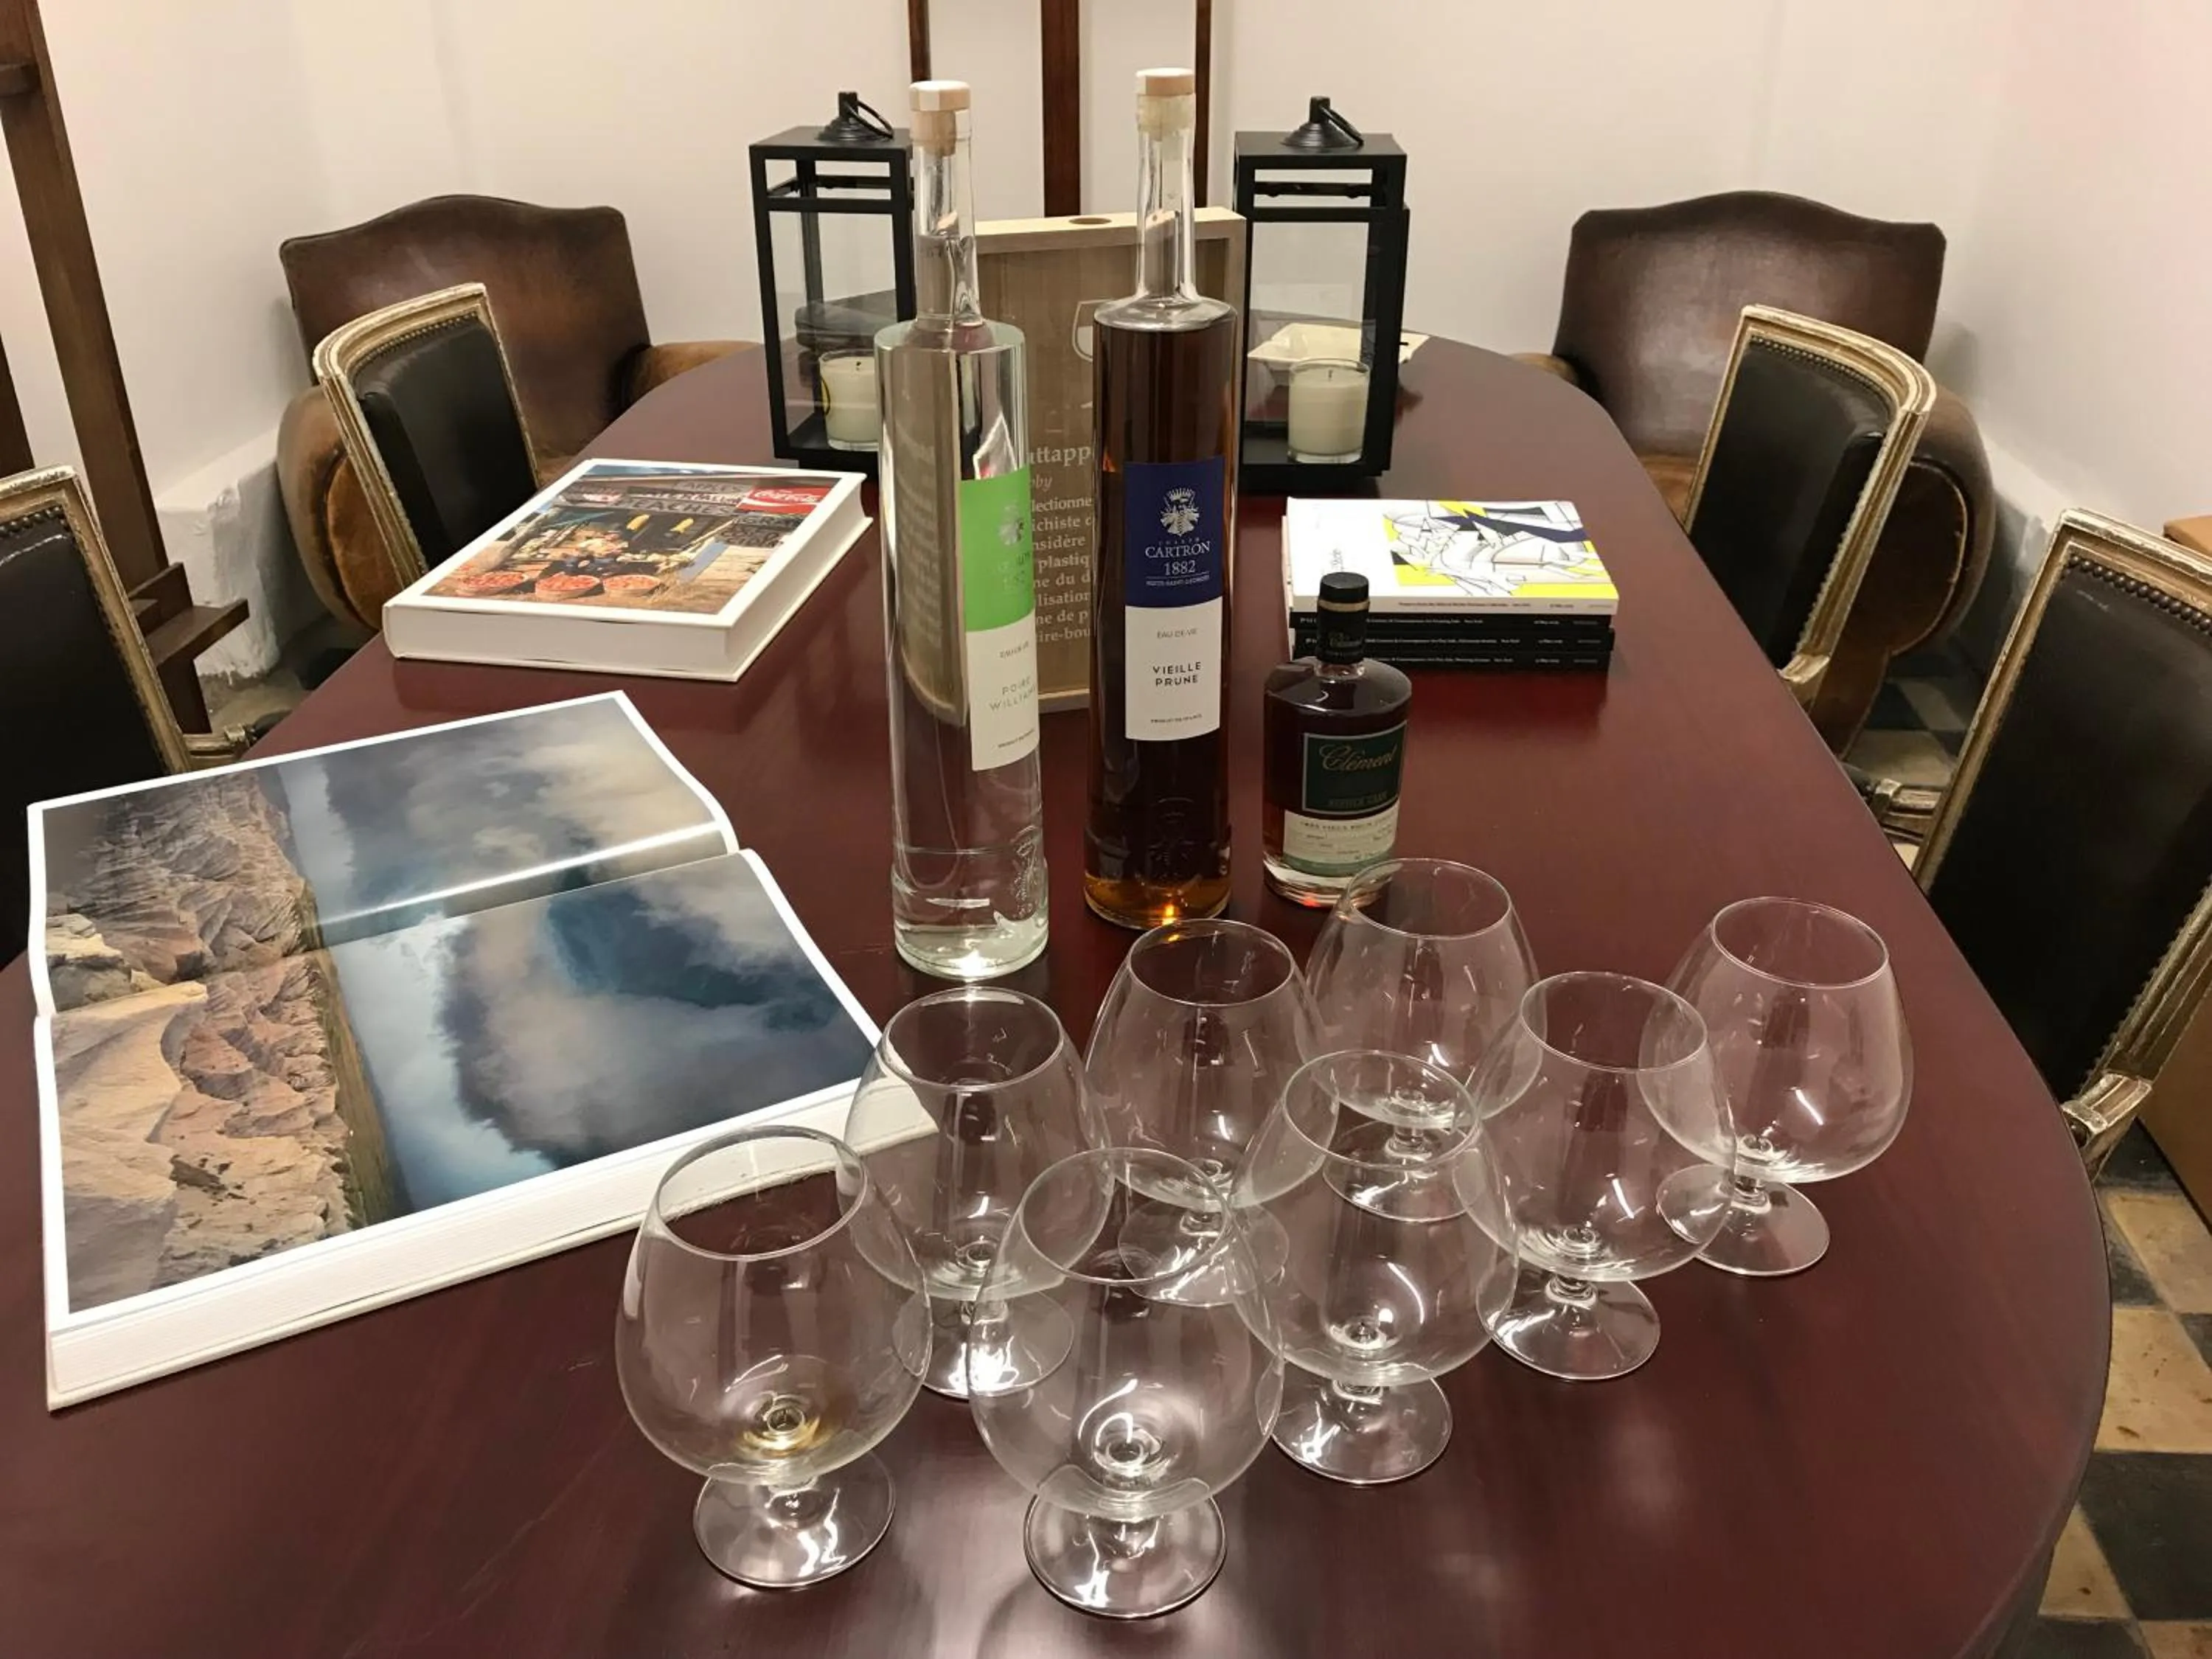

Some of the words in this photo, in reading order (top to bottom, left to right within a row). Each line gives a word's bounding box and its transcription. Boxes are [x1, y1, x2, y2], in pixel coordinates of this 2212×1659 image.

[1145, 540, 1211, 558] CARTRON
[1164, 560, 1195, 575] 1882
[1055, 573, 1076, 585] du
[1057, 610, 1074, 622] de
[1152, 661, 1201, 675] VIEILLE
[1155, 675, 1198, 686] PRUNE
